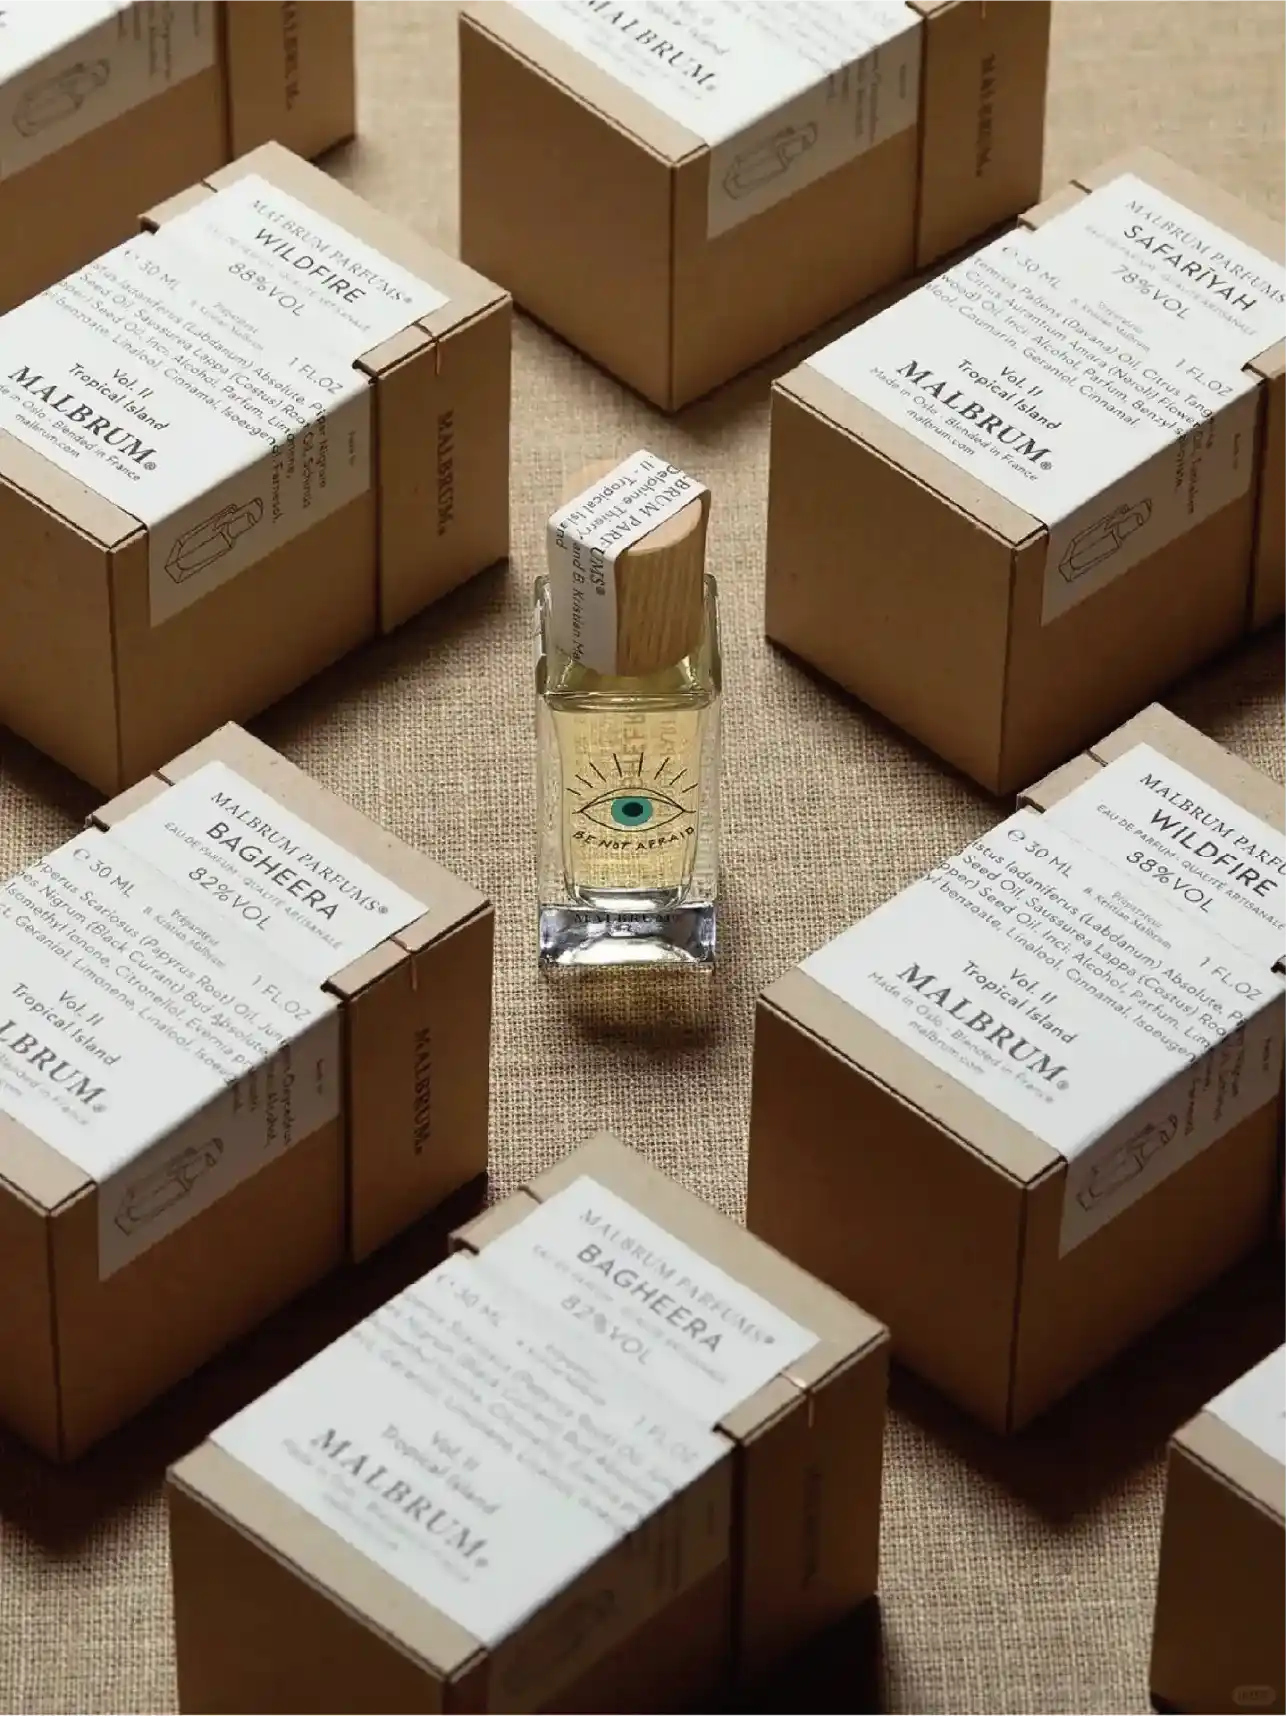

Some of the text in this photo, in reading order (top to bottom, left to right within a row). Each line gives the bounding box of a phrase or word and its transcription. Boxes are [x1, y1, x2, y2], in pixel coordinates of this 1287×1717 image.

[254, 227, 367, 304] WILDFIRE
[68, 362, 171, 431] Tropical Island
[111, 368, 155, 400] Vol. II
[957, 358, 1063, 430] Tropical Island
[1000, 366, 1044, 397] Vol. II
[944, 416, 993, 449] Blended
[1000, 453, 1039, 482] France
[583, 475, 637, 514] Tropical
[210, 791, 301, 856] MALBRUM
[573, 826, 696, 851] BE NOT AFRAID
[1139, 772, 1287, 876] MALBRUM PARFU
[1150, 808, 1279, 898] WILDFIRE
[88, 859, 135, 898] 30 ML
[205, 821, 339, 921] BAGHEERA
[1024, 840, 1072, 879] 30 ML
[1117, 818, 1136, 832] DE
[1132, 829, 1177, 858] PARFUM
[1224, 889, 1287, 931] ARTISANALE
[27, 858, 79, 894] yperus
[138, 934, 196, 980] (Papyrus
[37, 883, 87, 925] Nigrum
[188, 866, 272, 931] 82%VOL
[1004, 860, 1079, 916] ladaniferus
[1077, 912, 1164, 971] (Labdanum)
[961, 854, 1003, 882] Seed
[1024, 896, 1093, 948] Saussurea
[1092, 942, 1137, 978] Lappa
[1136, 973, 1200, 1017] (Costus)
[977, 886, 1018, 915] Seed
[1071, 951, 1129, 994] Alcohol,
[58, 989, 105, 1027] Vol. II
[867, 971, 901, 998] Made
[961, 959, 1079, 1044] Tropical Island
[1009, 967, 1058, 1005] Vol. II
[1199, 956, 1264, 1001] 1 FL.OZ
[11, 982, 122, 1067] Tropical Island
[0, 1019, 107, 1112] LBRUM®
[576, 1243, 723, 1353] BAGHEERA
[309, 1427, 489, 1568] MALBRUM
